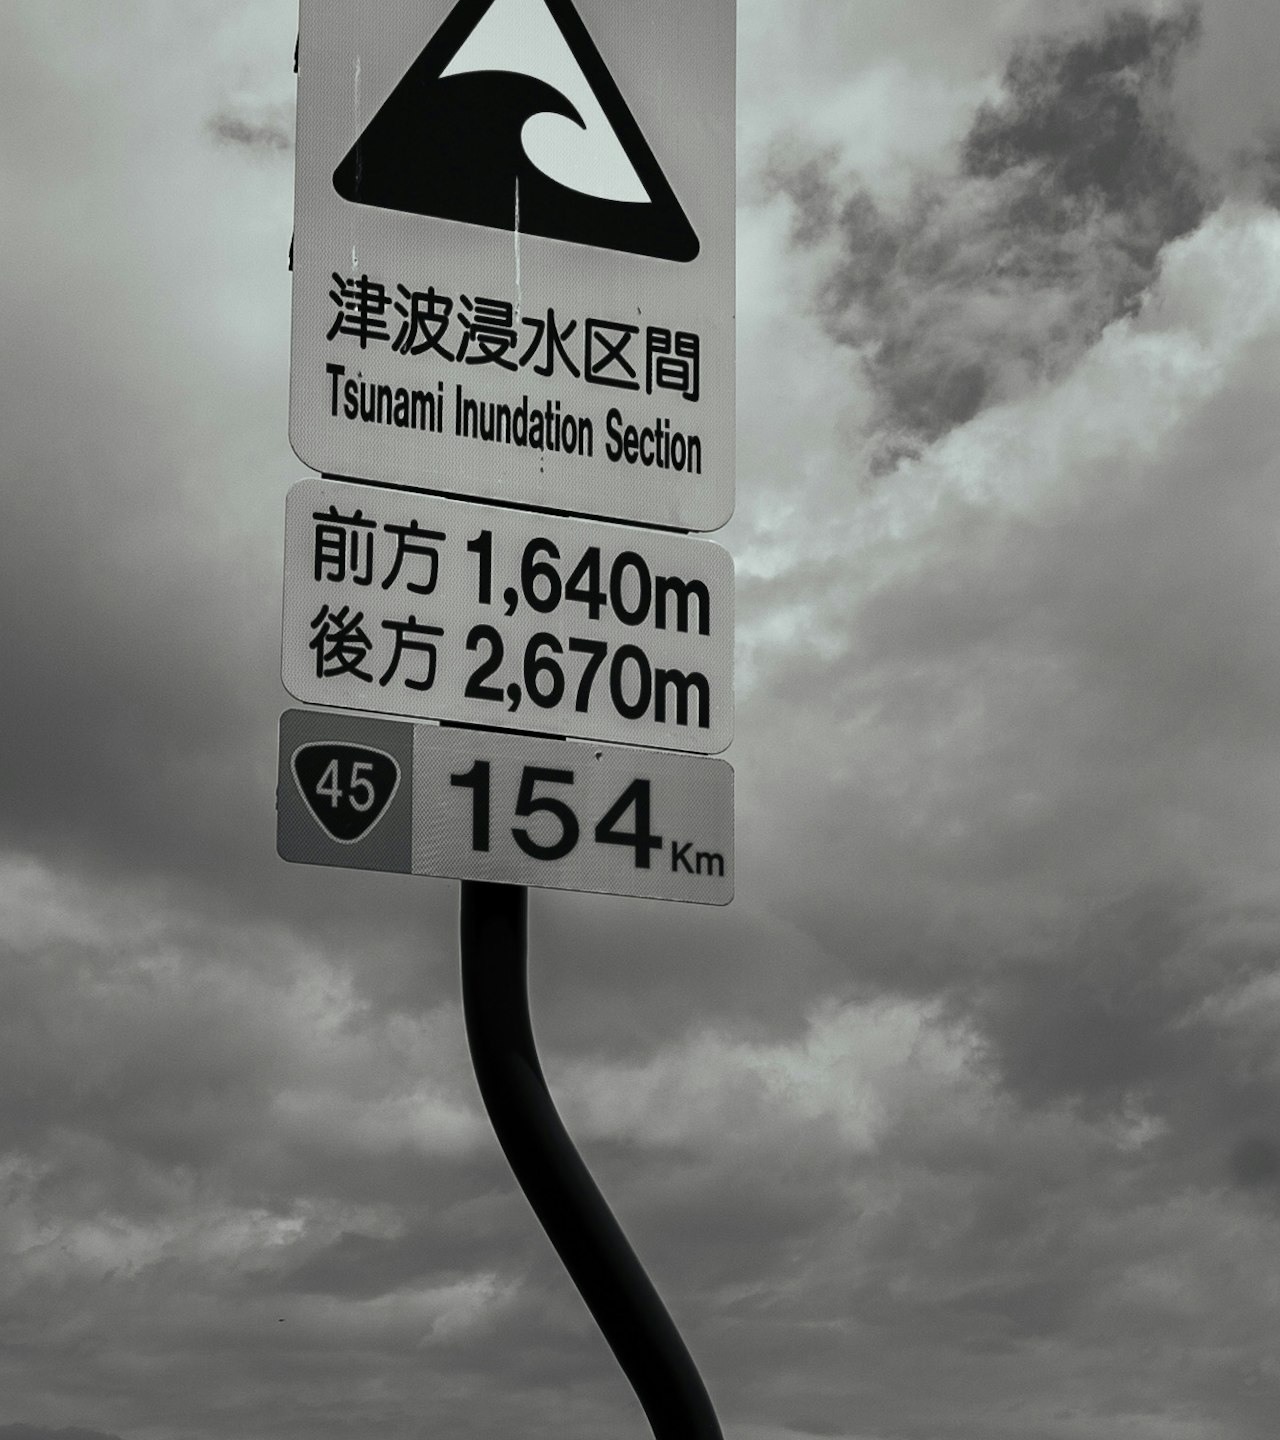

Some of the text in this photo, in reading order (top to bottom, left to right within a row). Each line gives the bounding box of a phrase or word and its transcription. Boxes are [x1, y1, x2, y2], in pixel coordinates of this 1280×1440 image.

[327, 272, 699, 402] 津波浸水区間
[326, 363, 701, 474] Tsunami Inundation Section
[313, 505, 709, 635] 前方 1,640m
[309, 605, 709, 728] 後方 2,670m
[316, 758, 375, 812] 45
[450, 760, 662, 869] 154
